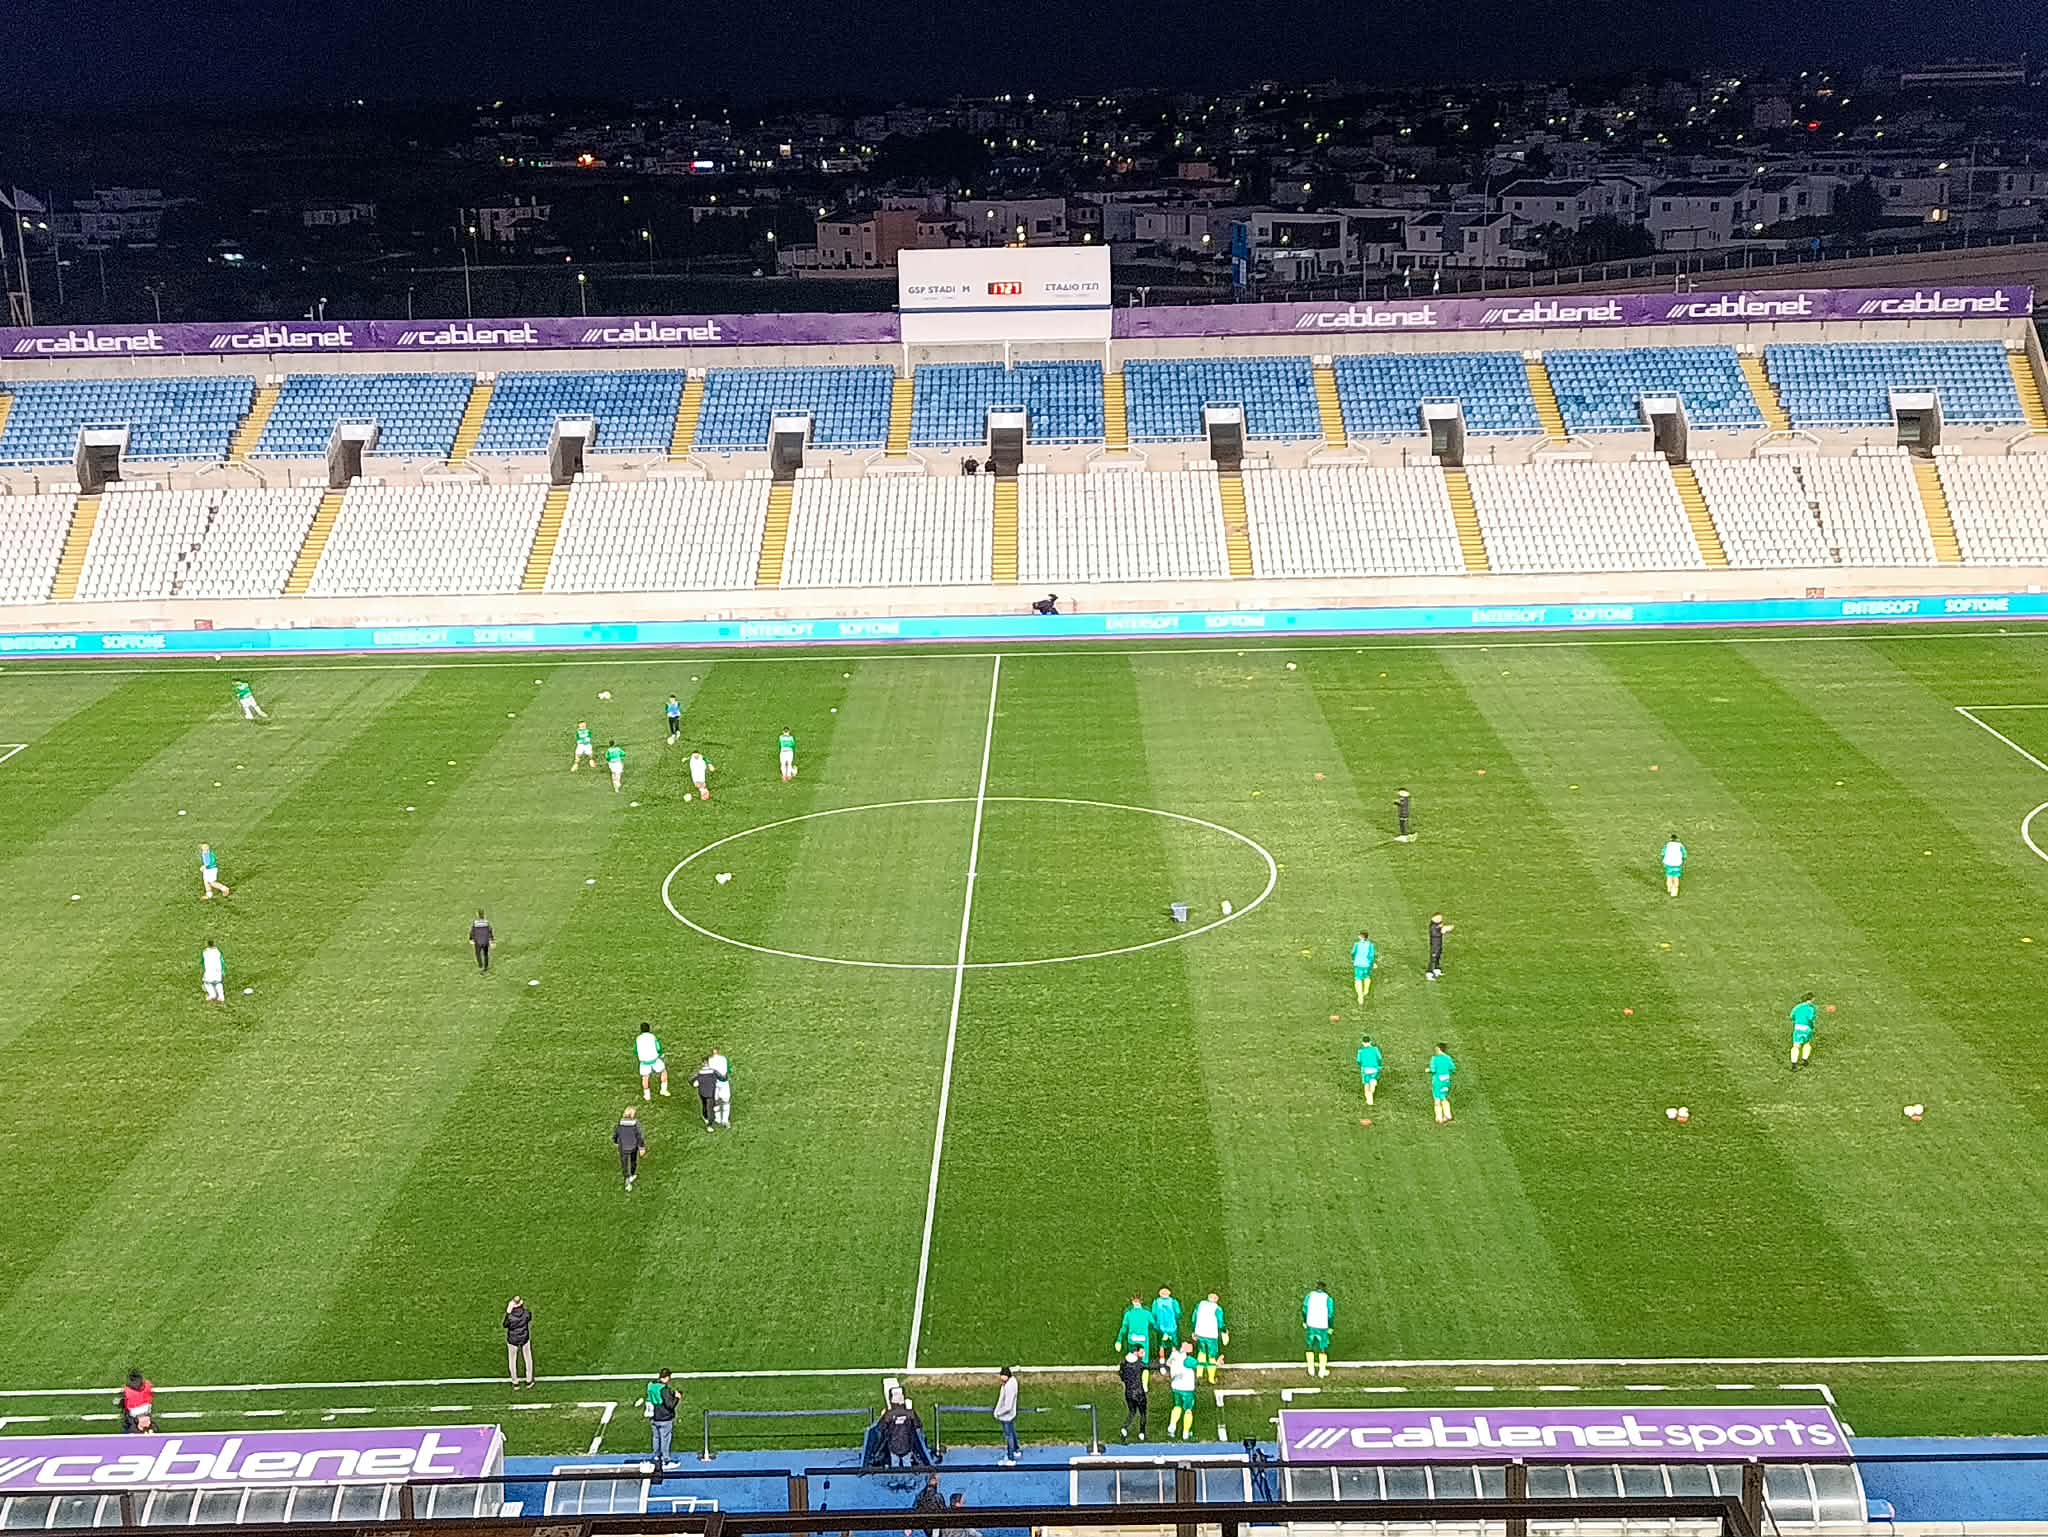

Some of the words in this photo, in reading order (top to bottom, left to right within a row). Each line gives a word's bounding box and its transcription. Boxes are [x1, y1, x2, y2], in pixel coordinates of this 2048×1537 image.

[1494, 297, 1622, 322] cablenet
[1686, 293, 1812, 318] cablenet
[1881, 289, 2009, 313] cablenet
[1317, 303, 1437, 328] cablenet
[37, 329, 163, 353] cablenet
[232, 326, 352, 349] cablenet
[419, 323, 538, 345] cablenet
[603, 320, 721, 343] cablenet
[1945, 598, 2008, 612] SOFTONE
[35, 1432, 463, 1485] cablenet
